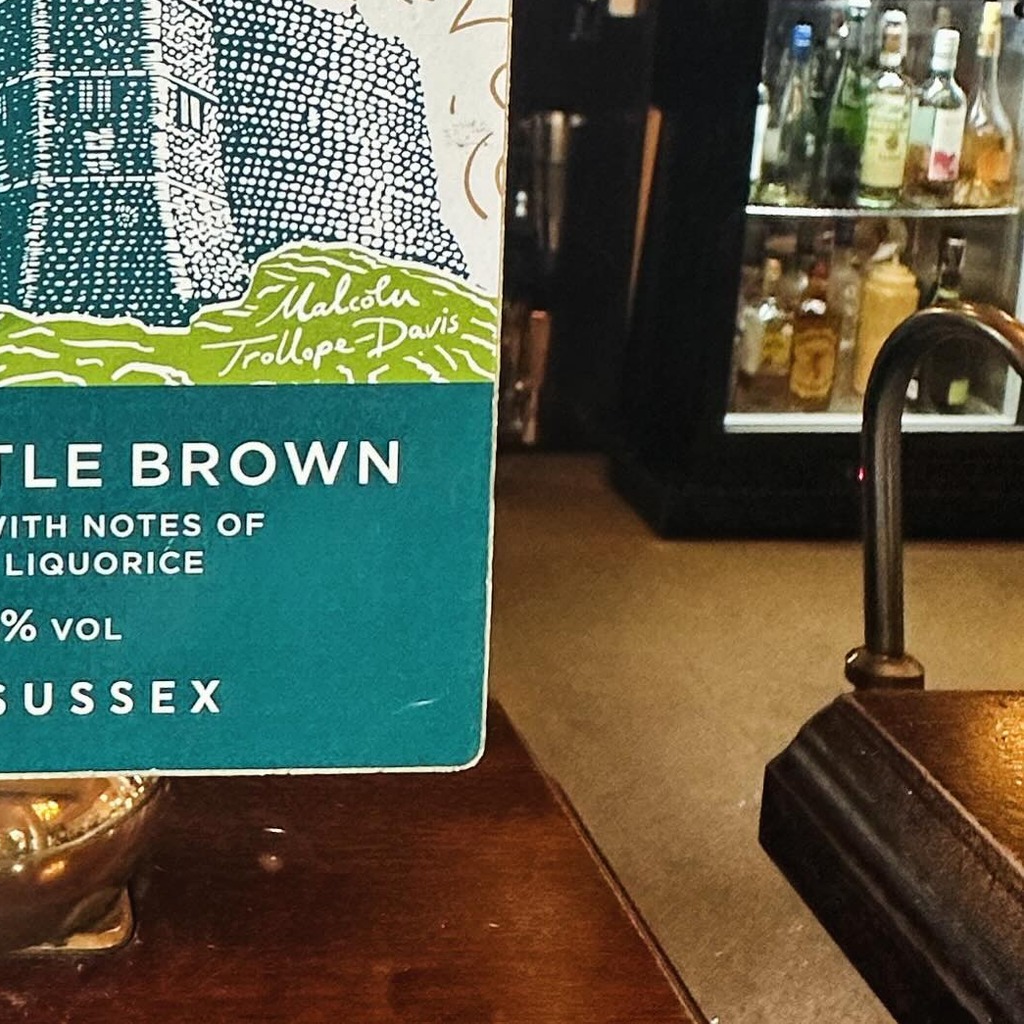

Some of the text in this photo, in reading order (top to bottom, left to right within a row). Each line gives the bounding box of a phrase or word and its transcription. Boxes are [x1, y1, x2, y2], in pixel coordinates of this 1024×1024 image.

[132, 440, 399, 487] BROWN
[84, 513, 201, 538] NOTES
[217, 512, 265, 537] OF
[6, 550, 204, 576] LIQUORICE
[51, 617, 122, 641] VOL
